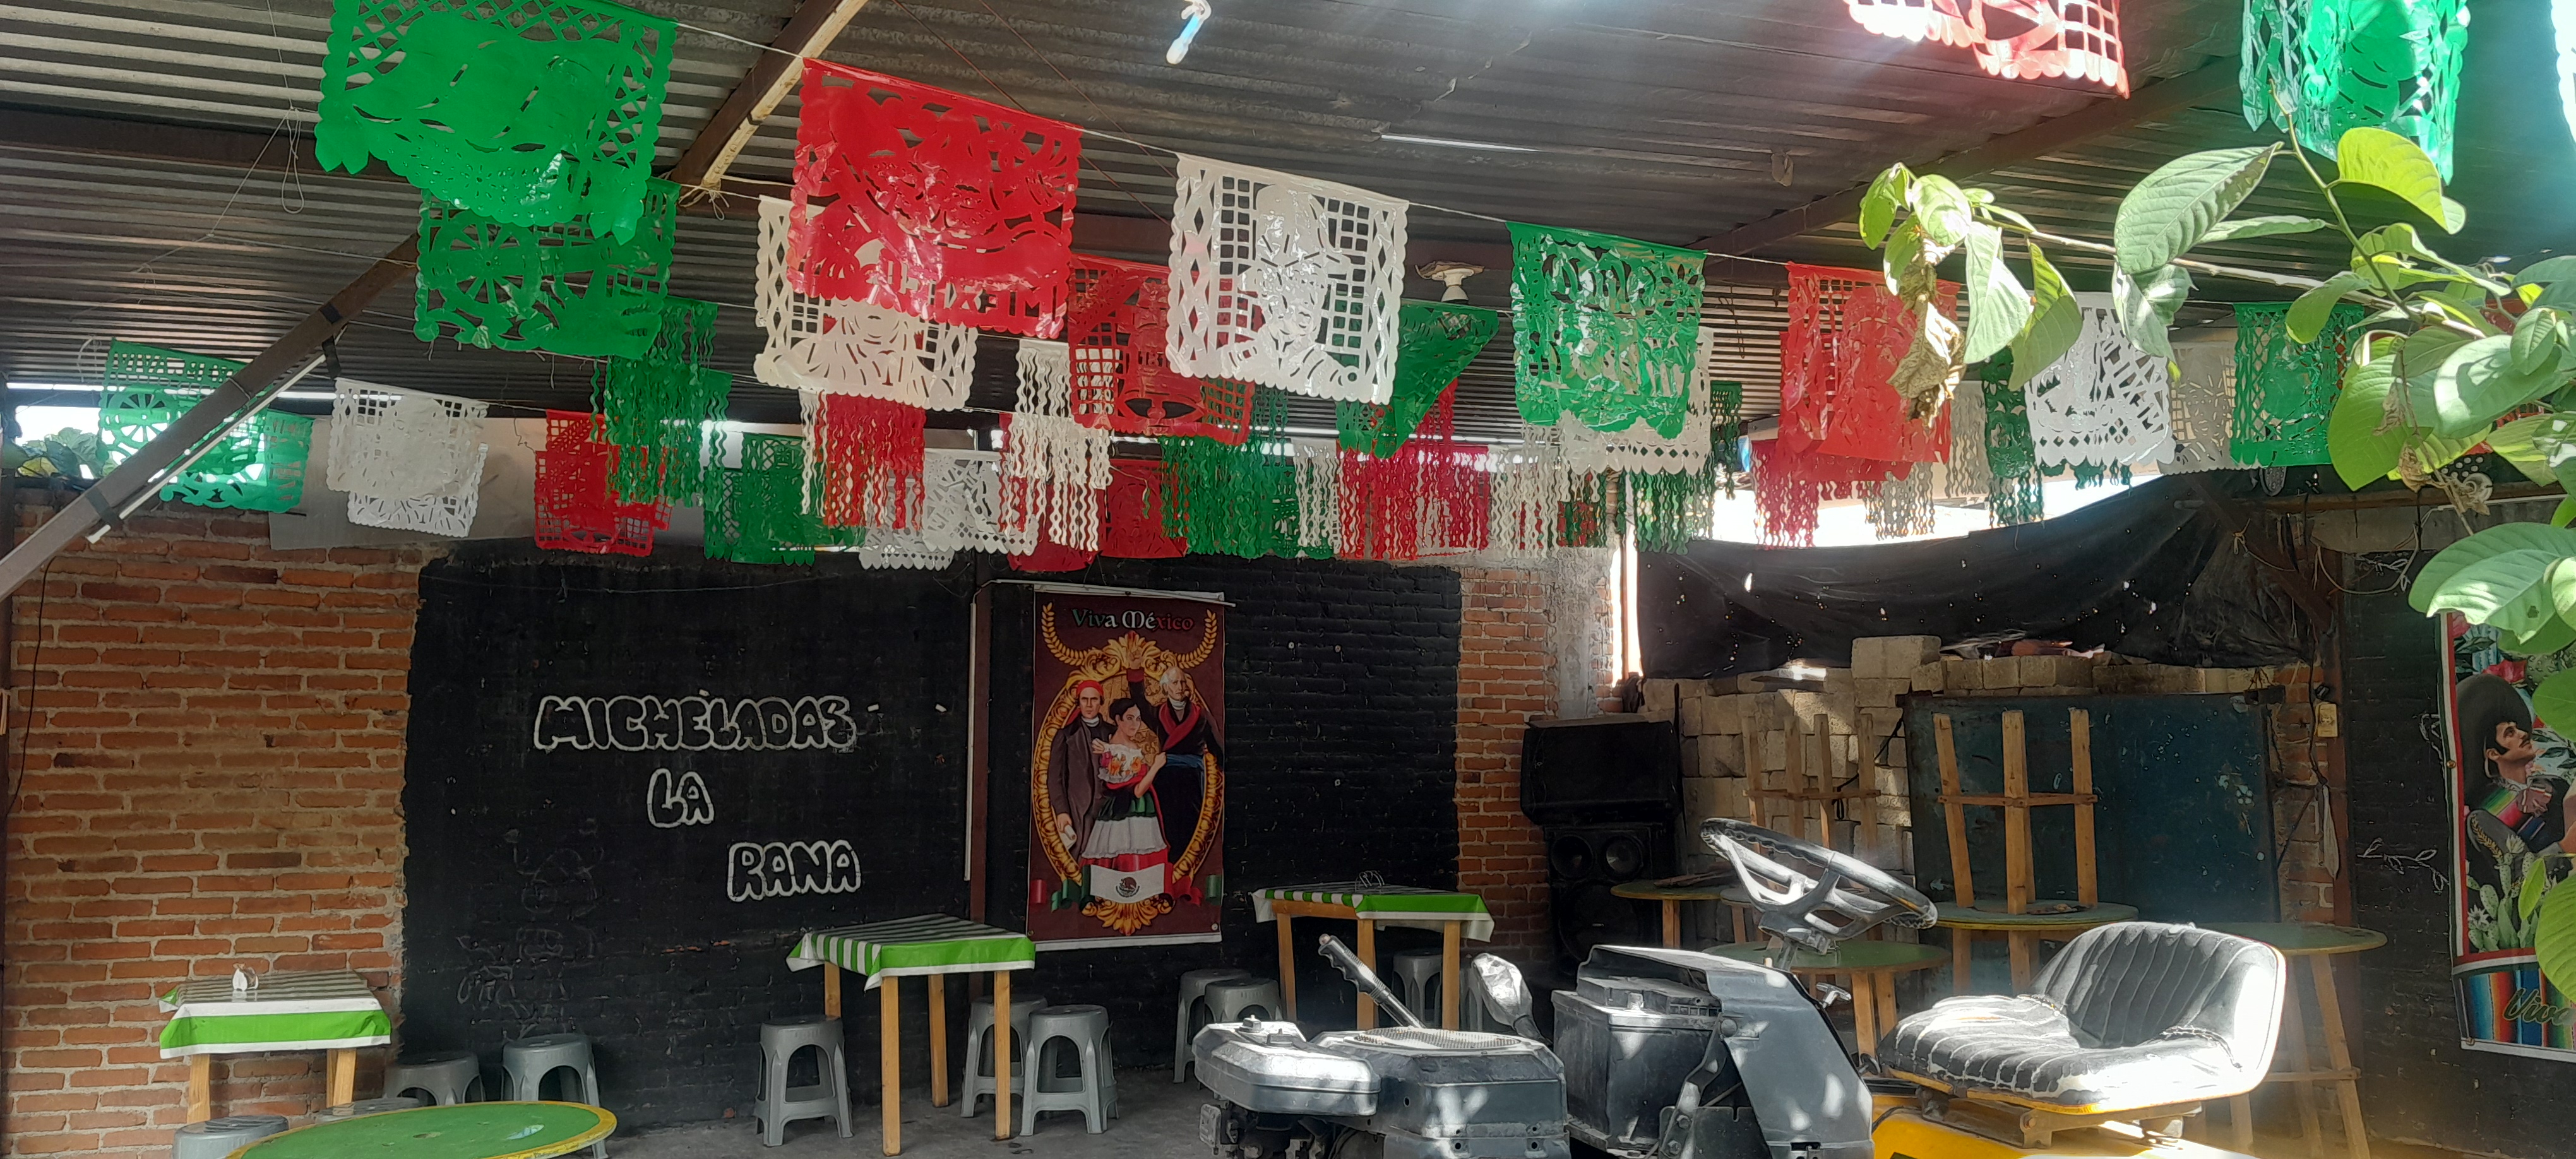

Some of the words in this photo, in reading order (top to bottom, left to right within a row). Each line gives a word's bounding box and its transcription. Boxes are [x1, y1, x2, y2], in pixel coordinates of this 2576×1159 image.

[1071, 609, 1118, 627] Viva
[1123, 610, 1193, 630] México
[534, 694, 856, 751] MICHELADAS
[647, 768, 715, 828] LA
[728, 840, 861, 901] RANA
